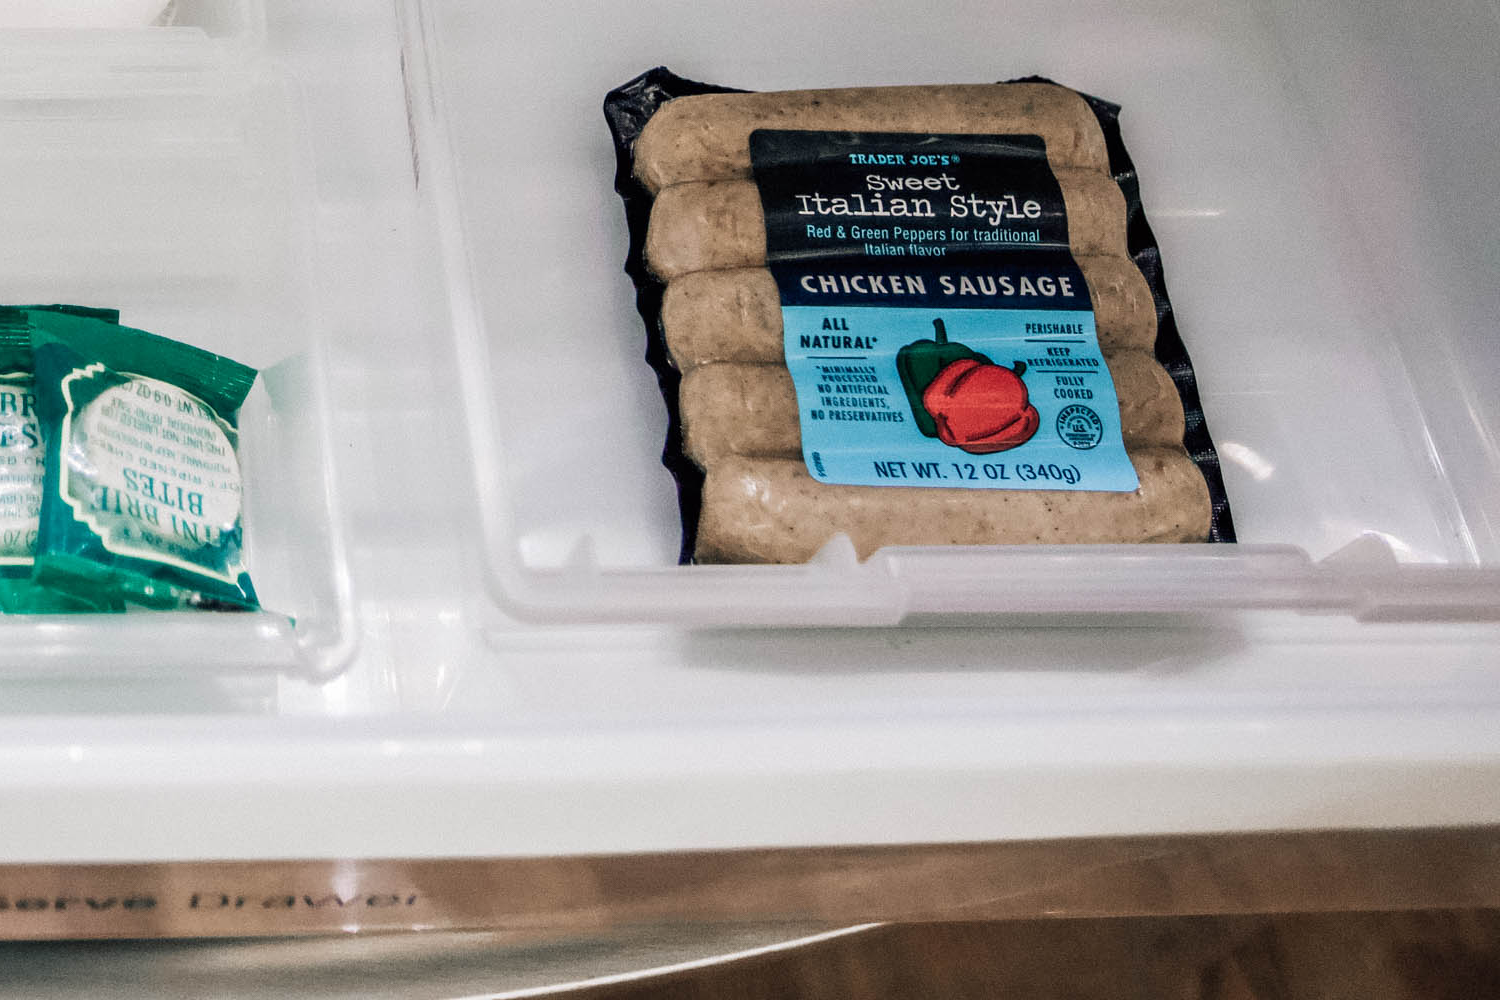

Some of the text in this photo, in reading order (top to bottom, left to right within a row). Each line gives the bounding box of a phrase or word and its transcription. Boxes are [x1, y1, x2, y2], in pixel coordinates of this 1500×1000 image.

[849, 153, 906, 166] TRADER
[866, 173, 960, 191] Sweet
[795, 194, 1042, 226] Italian Style
[806, 224, 1041, 244] Red & Green Peppers for traditional
[864, 242, 947, 257] Italian flavor
[800, 275, 1075, 298] CHICKEN SAUSAGE
[822, 317, 850, 331] ALL
[1025, 323, 1084, 334] PERISHABLE
[1046, 347, 1071, 356] KEEP
[1027, 358, 1099, 367] REFRIGERATED
[822, 374, 878, 383] PROCESSED
[1056, 376, 1085, 386] FULLY
[136, 383, 151, 399] OZ
[817, 384, 890, 395] NO ARTIFICIAL
[1054, 388, 1093, 400] COOKED
[0, 391, 37, 418] BR
[821, 396, 890, 410] INGREDIENTS,
[811, 410, 905, 423] NO PRESERVATIVES
[1059, 407, 1099, 425] INSPECTED
[162, 429, 180, 443] NOT
[183, 435, 204, 452] UNIT
[203, 444, 226, 457] THIS
[873, 461, 1082, 485] NET WT. 12 OZ (340g)
[123, 467, 204, 517] BITES
[91, 486, 160, 526] BRIE
